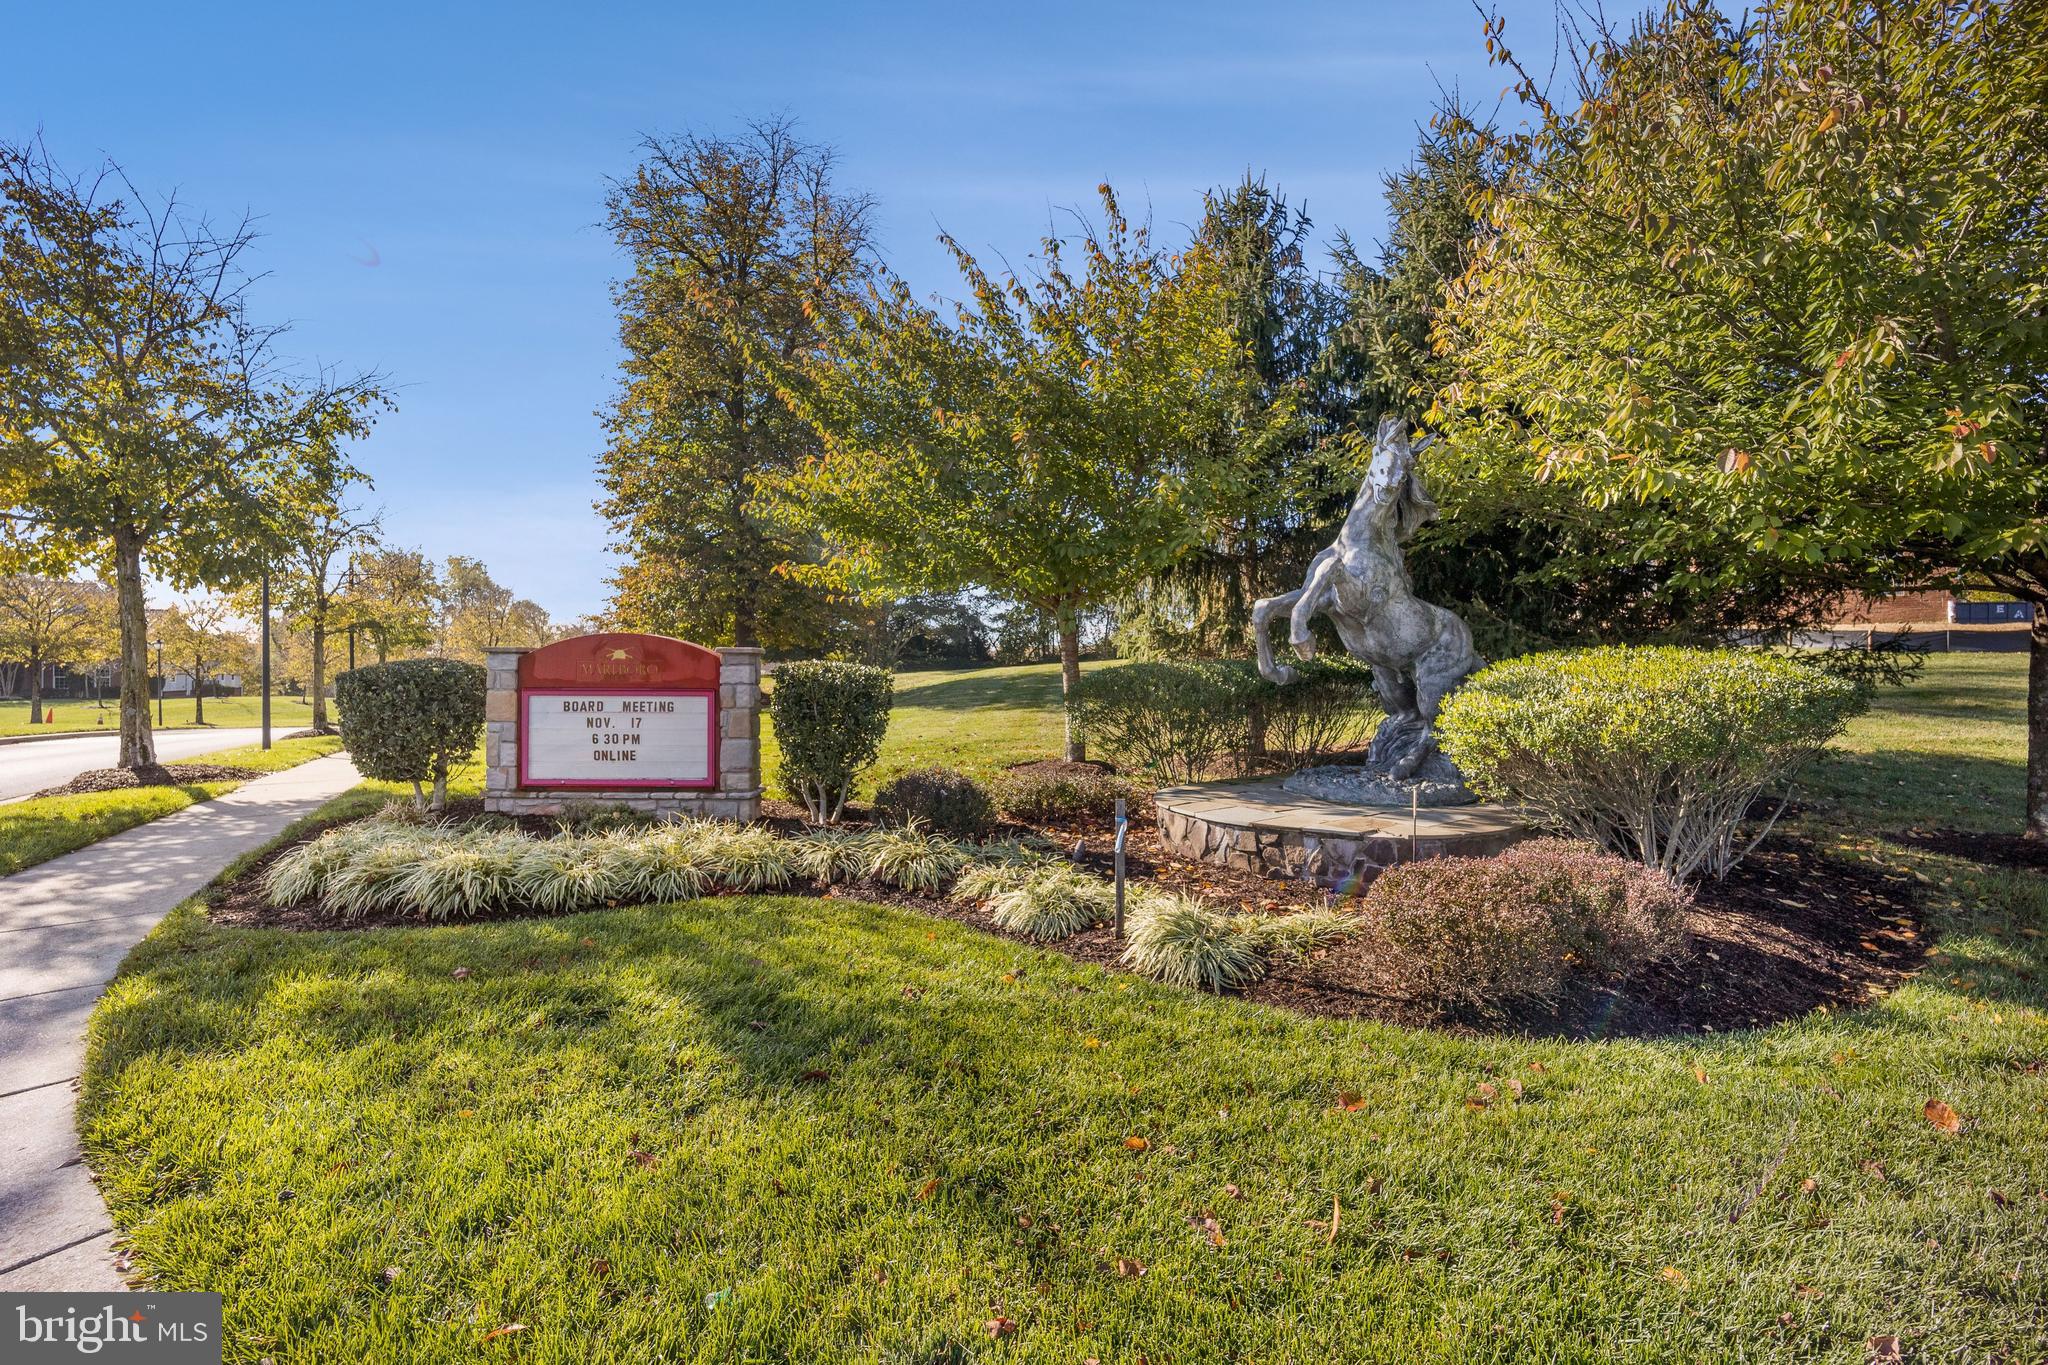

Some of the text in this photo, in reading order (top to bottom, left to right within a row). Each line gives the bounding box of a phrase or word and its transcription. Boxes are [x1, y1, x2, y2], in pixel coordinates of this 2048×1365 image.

[582, 663, 659, 675] MARLBORO
[563, 701, 675, 713] BOARD MEETING
[586, 717, 642, 729] NOV. 17
[593, 750, 636, 761] ONLINE
